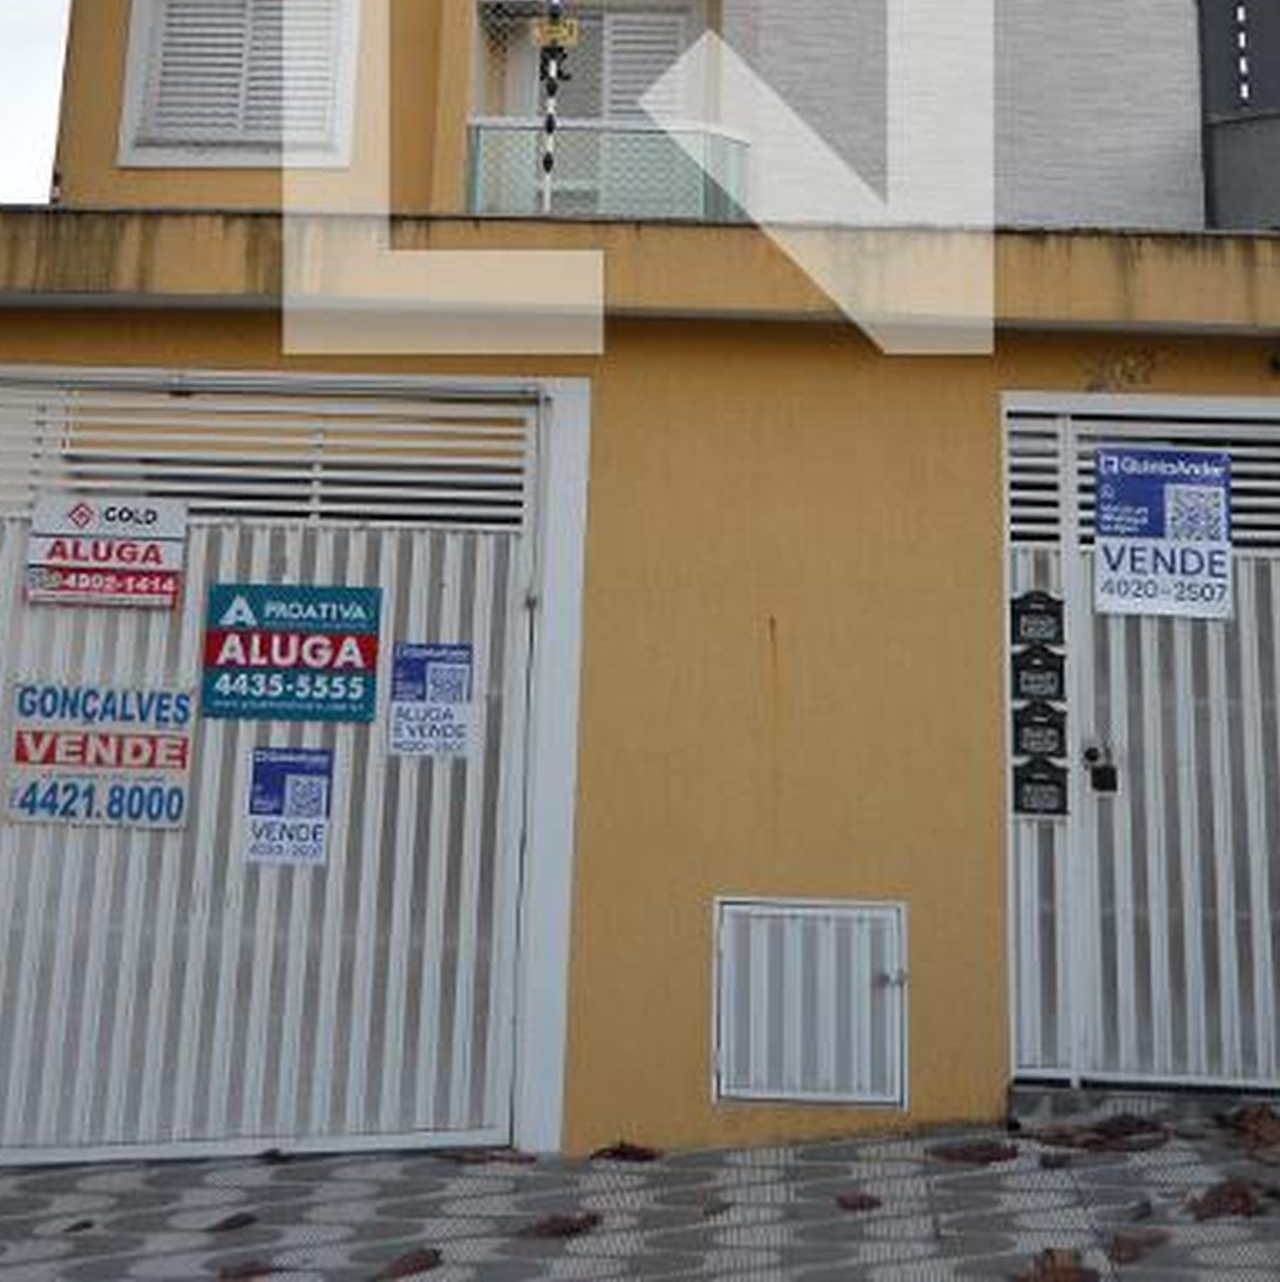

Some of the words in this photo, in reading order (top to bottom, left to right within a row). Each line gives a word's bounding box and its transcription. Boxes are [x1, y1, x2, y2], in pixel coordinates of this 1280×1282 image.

[47, 538, 163, 565] ALUGA
[1102, 544, 1228, 579] VENDE
[1100, 578, 1228, 602] 4020-2507
[265, 602, 368, 621] PROATIVA
[216, 632, 366, 669] ALUGA
[17, 685, 191, 725] GONÇALVES
[23, 731, 184, 768] VENDE
[18, 781, 184, 821] 4421.8000
[250, 819, 324, 842] VENDE
